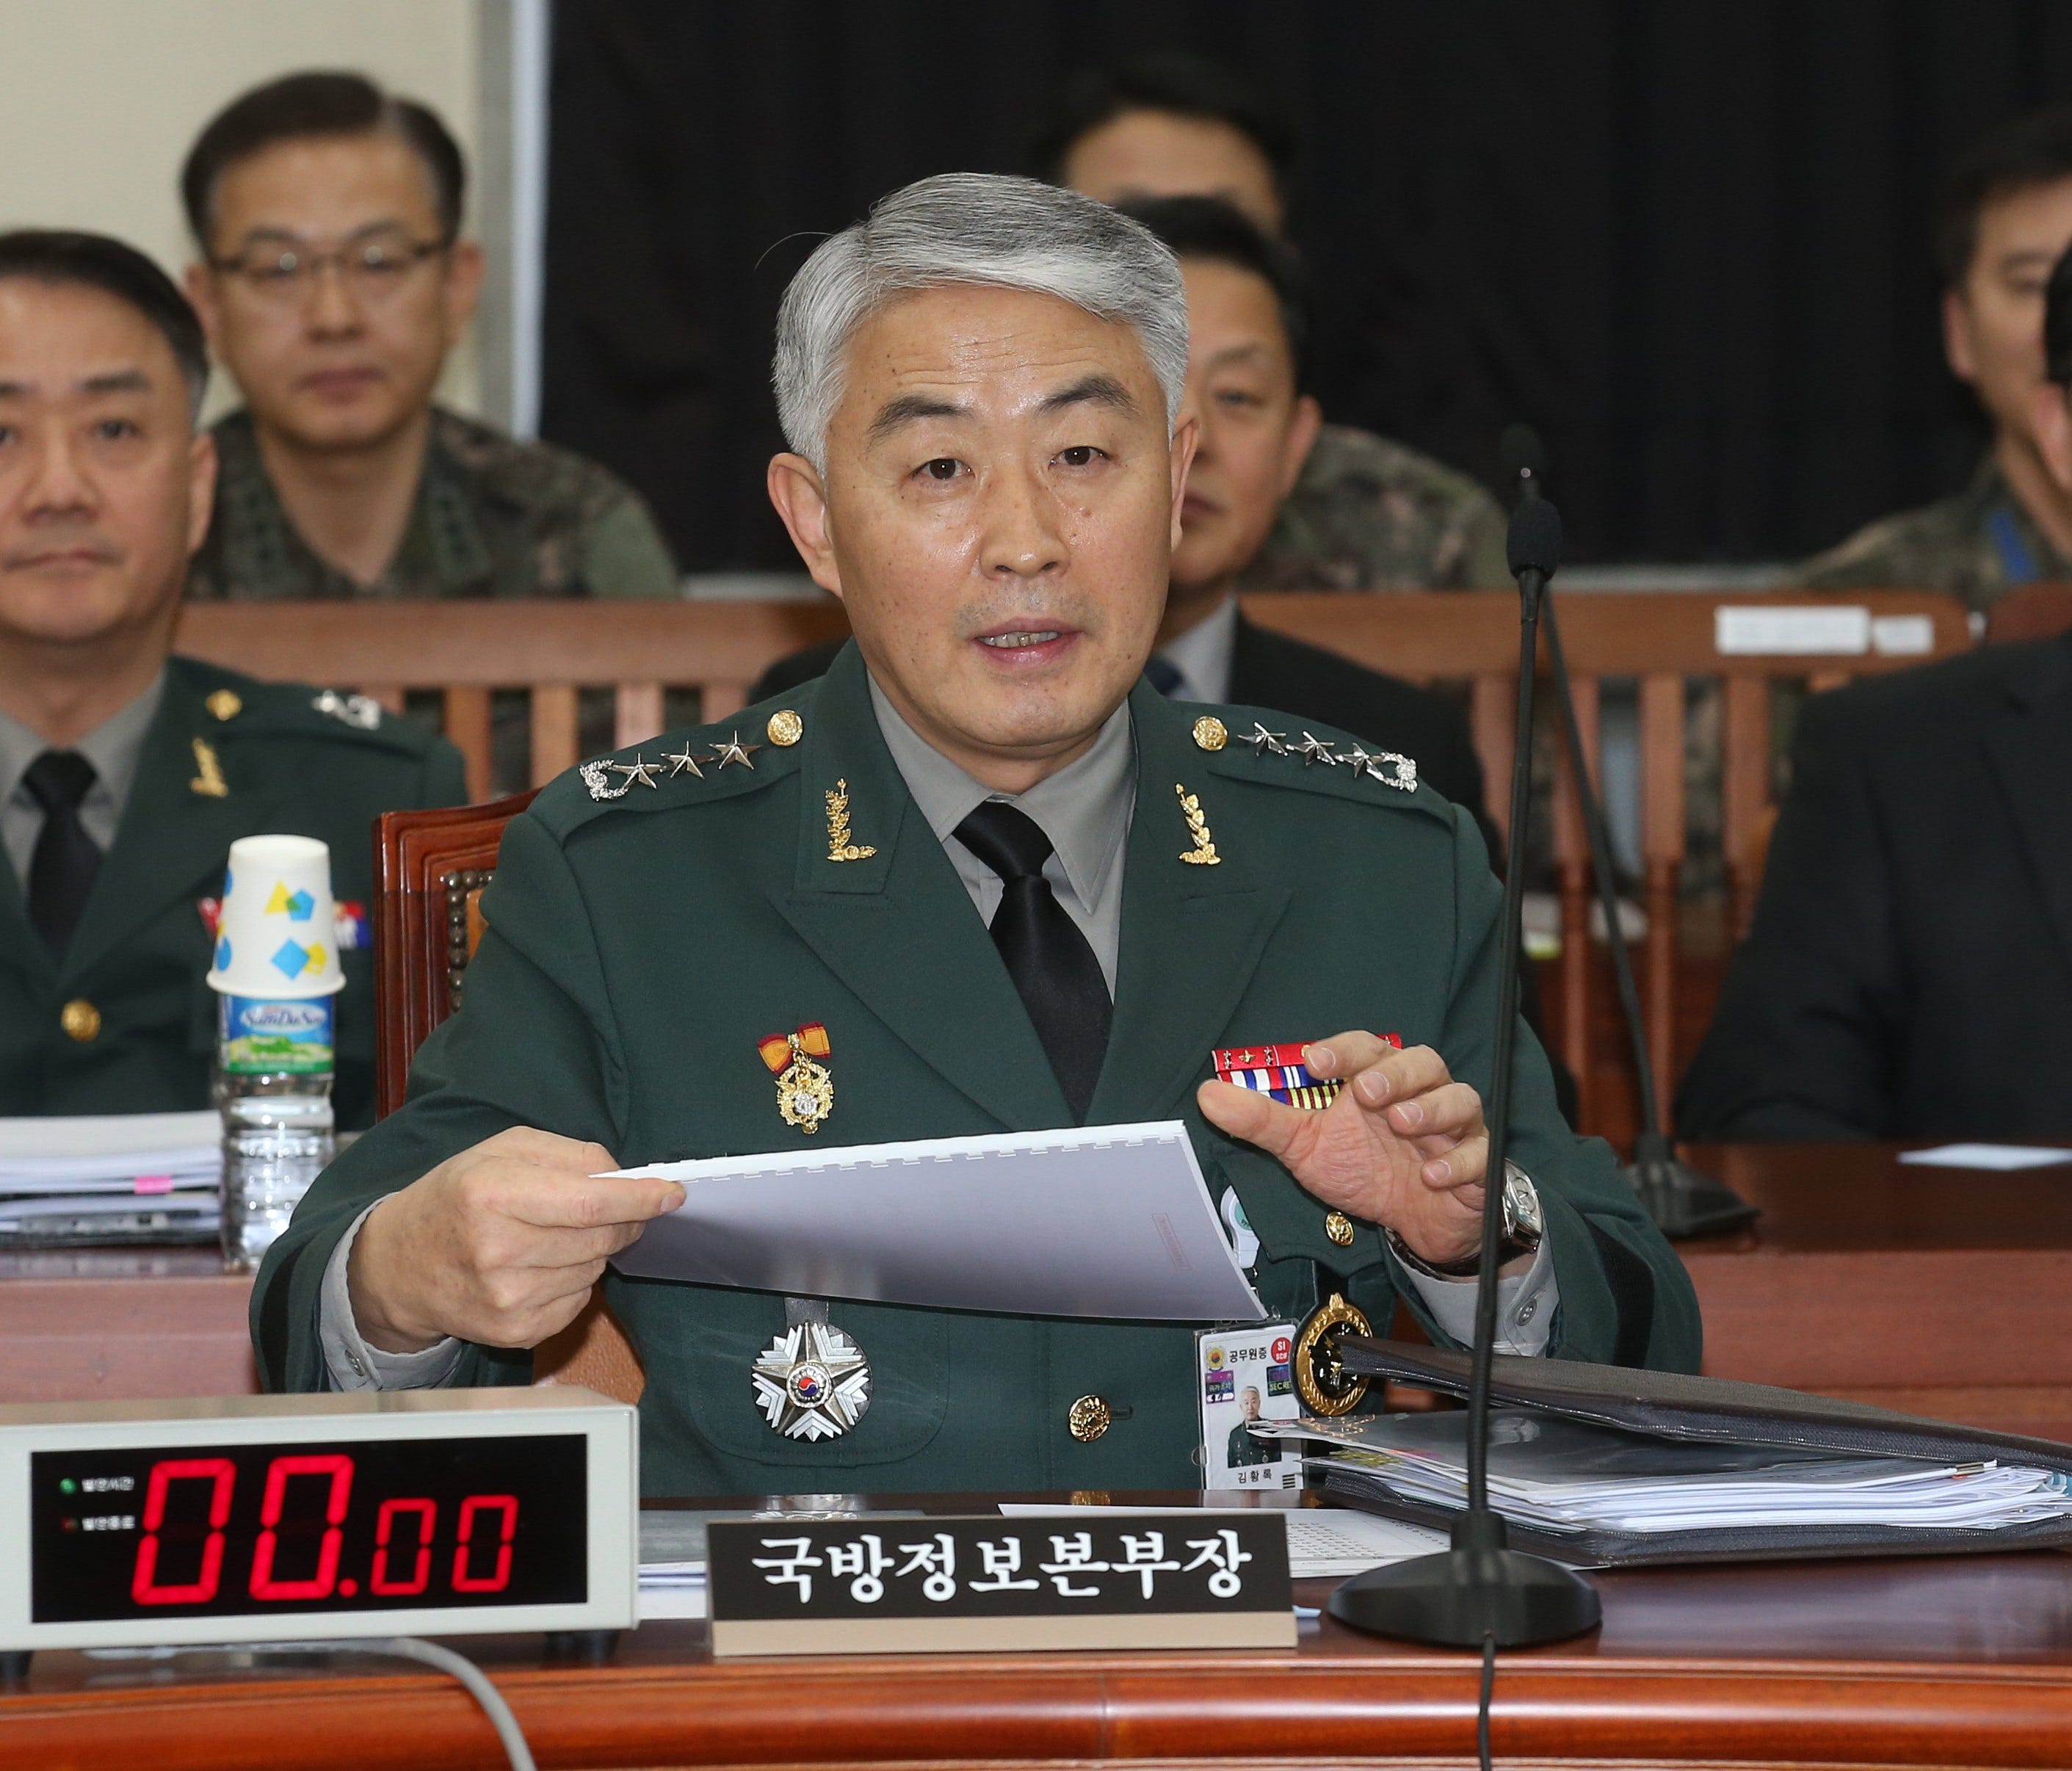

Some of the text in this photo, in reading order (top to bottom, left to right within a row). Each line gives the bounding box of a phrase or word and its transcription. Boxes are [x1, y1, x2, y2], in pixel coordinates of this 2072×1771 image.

[1277, 1341, 1286, 1351] SI
[1229, 1347, 1267, 1363] 공무원증
[1269, 1381, 1291, 1391] SECRE
[131, 1454, 519, 1605] 00.00
[751, 1529, 1253, 1604] 국방정보본부장
